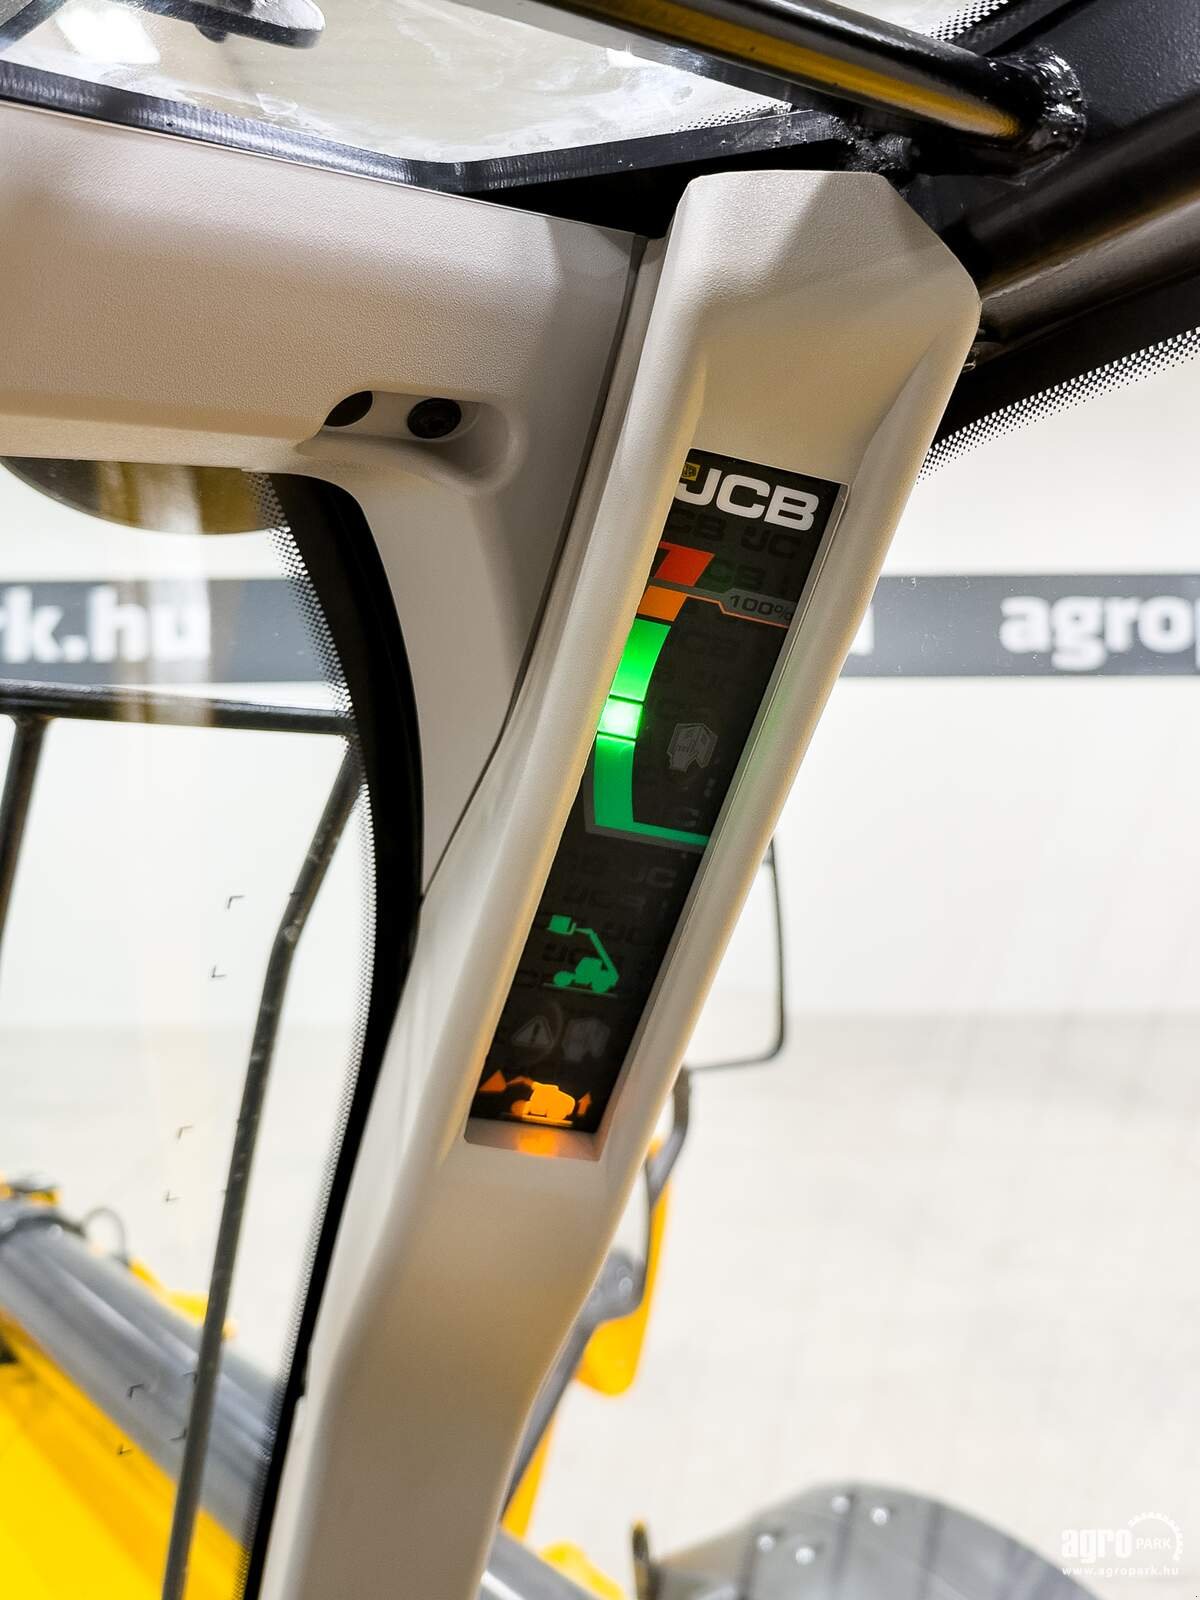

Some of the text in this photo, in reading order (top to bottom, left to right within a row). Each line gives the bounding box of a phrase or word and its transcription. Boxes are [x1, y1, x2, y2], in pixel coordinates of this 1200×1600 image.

[673, 468, 820, 531] JCB
[731, 594, 793, 621] 100%
[1000, 596, 1200, 672] agro
